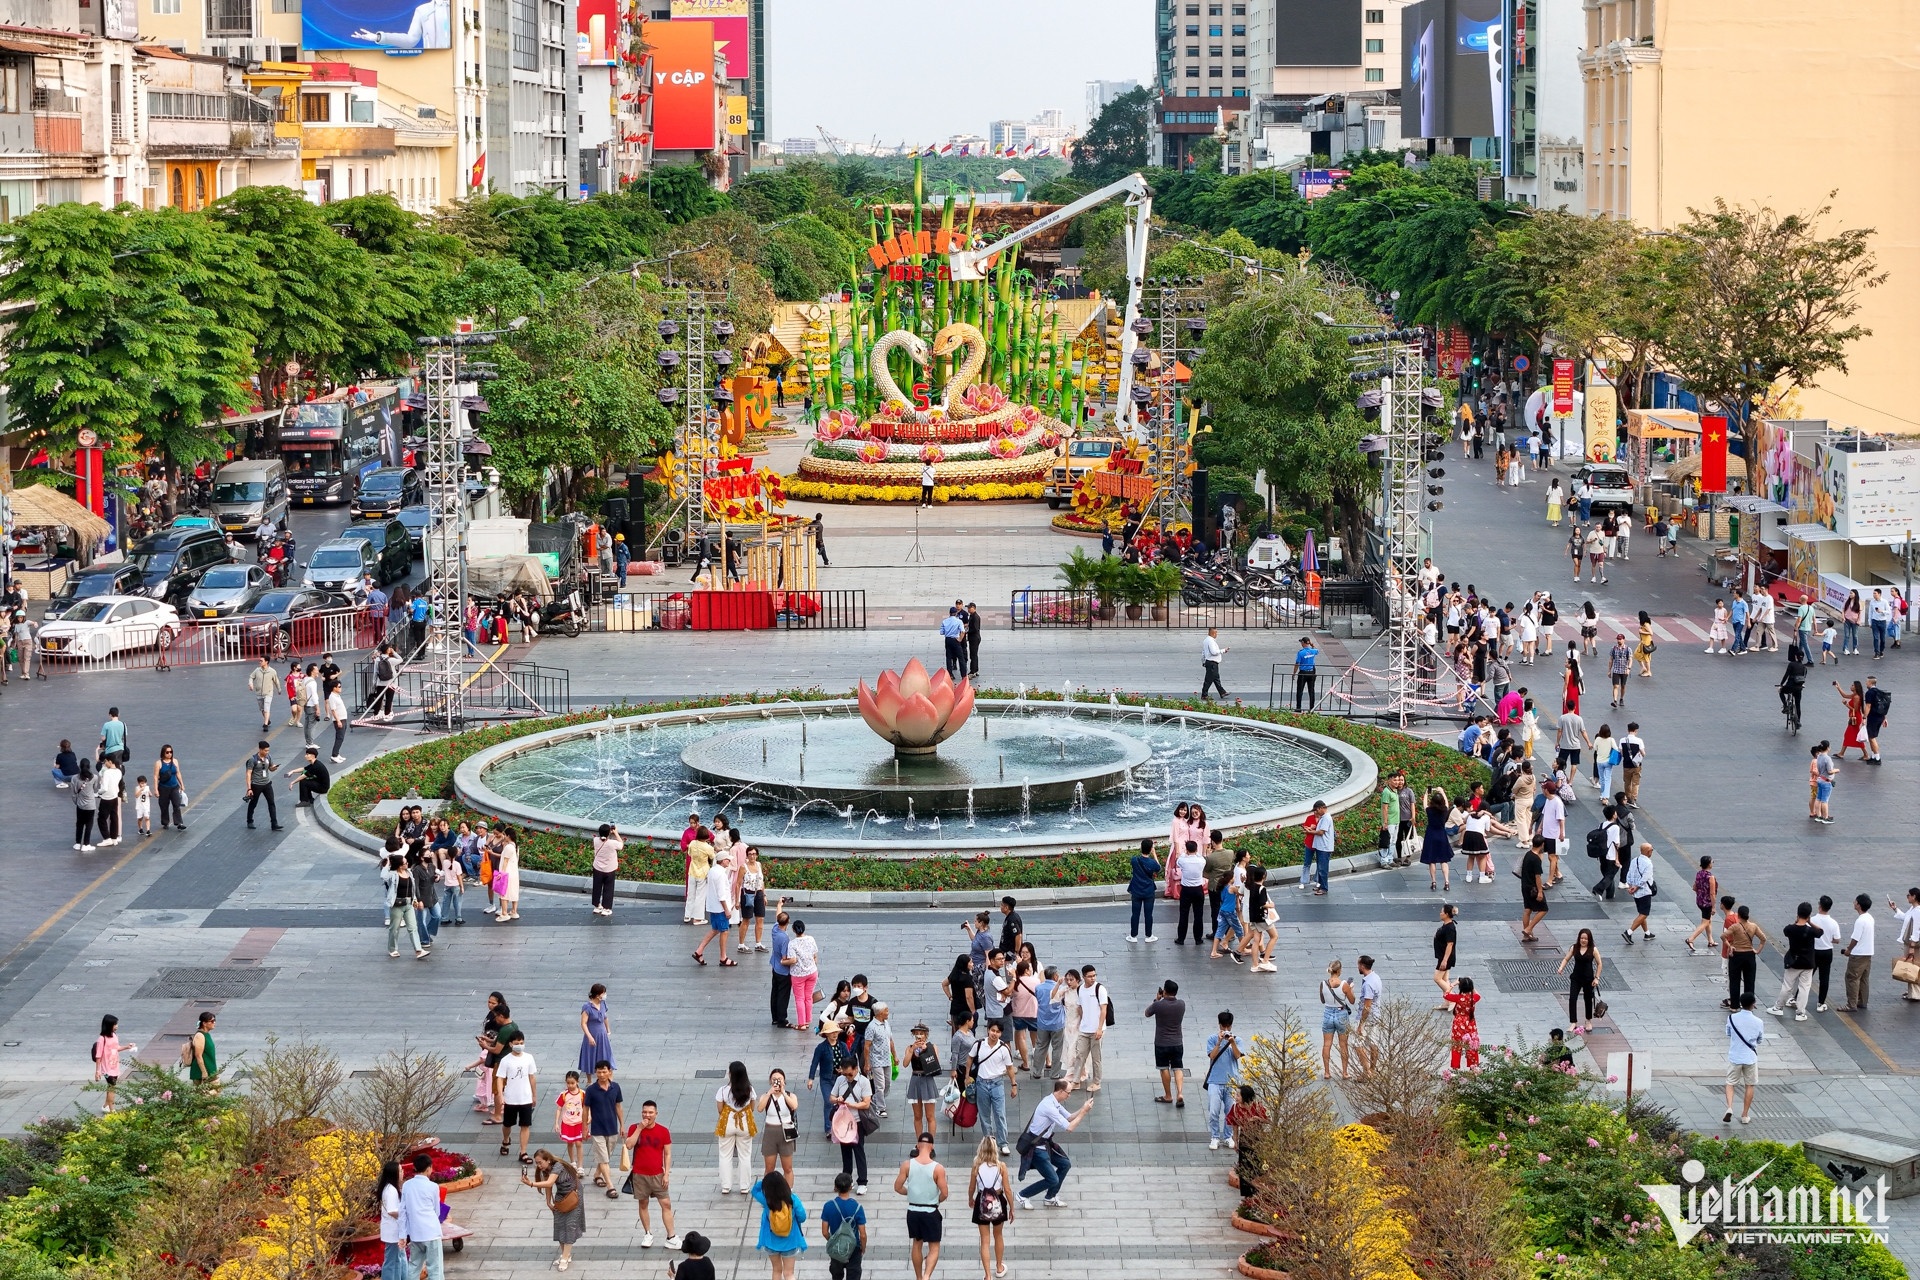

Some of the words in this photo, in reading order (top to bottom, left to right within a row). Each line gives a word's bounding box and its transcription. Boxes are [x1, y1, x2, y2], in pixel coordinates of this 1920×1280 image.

[655, 73, 667, 84] Y
[671, 69, 705, 87] CẬP
[729, 115, 742, 125] 89
[888, 265, 922, 281] 1975
[141, 794, 147, 803] 9
